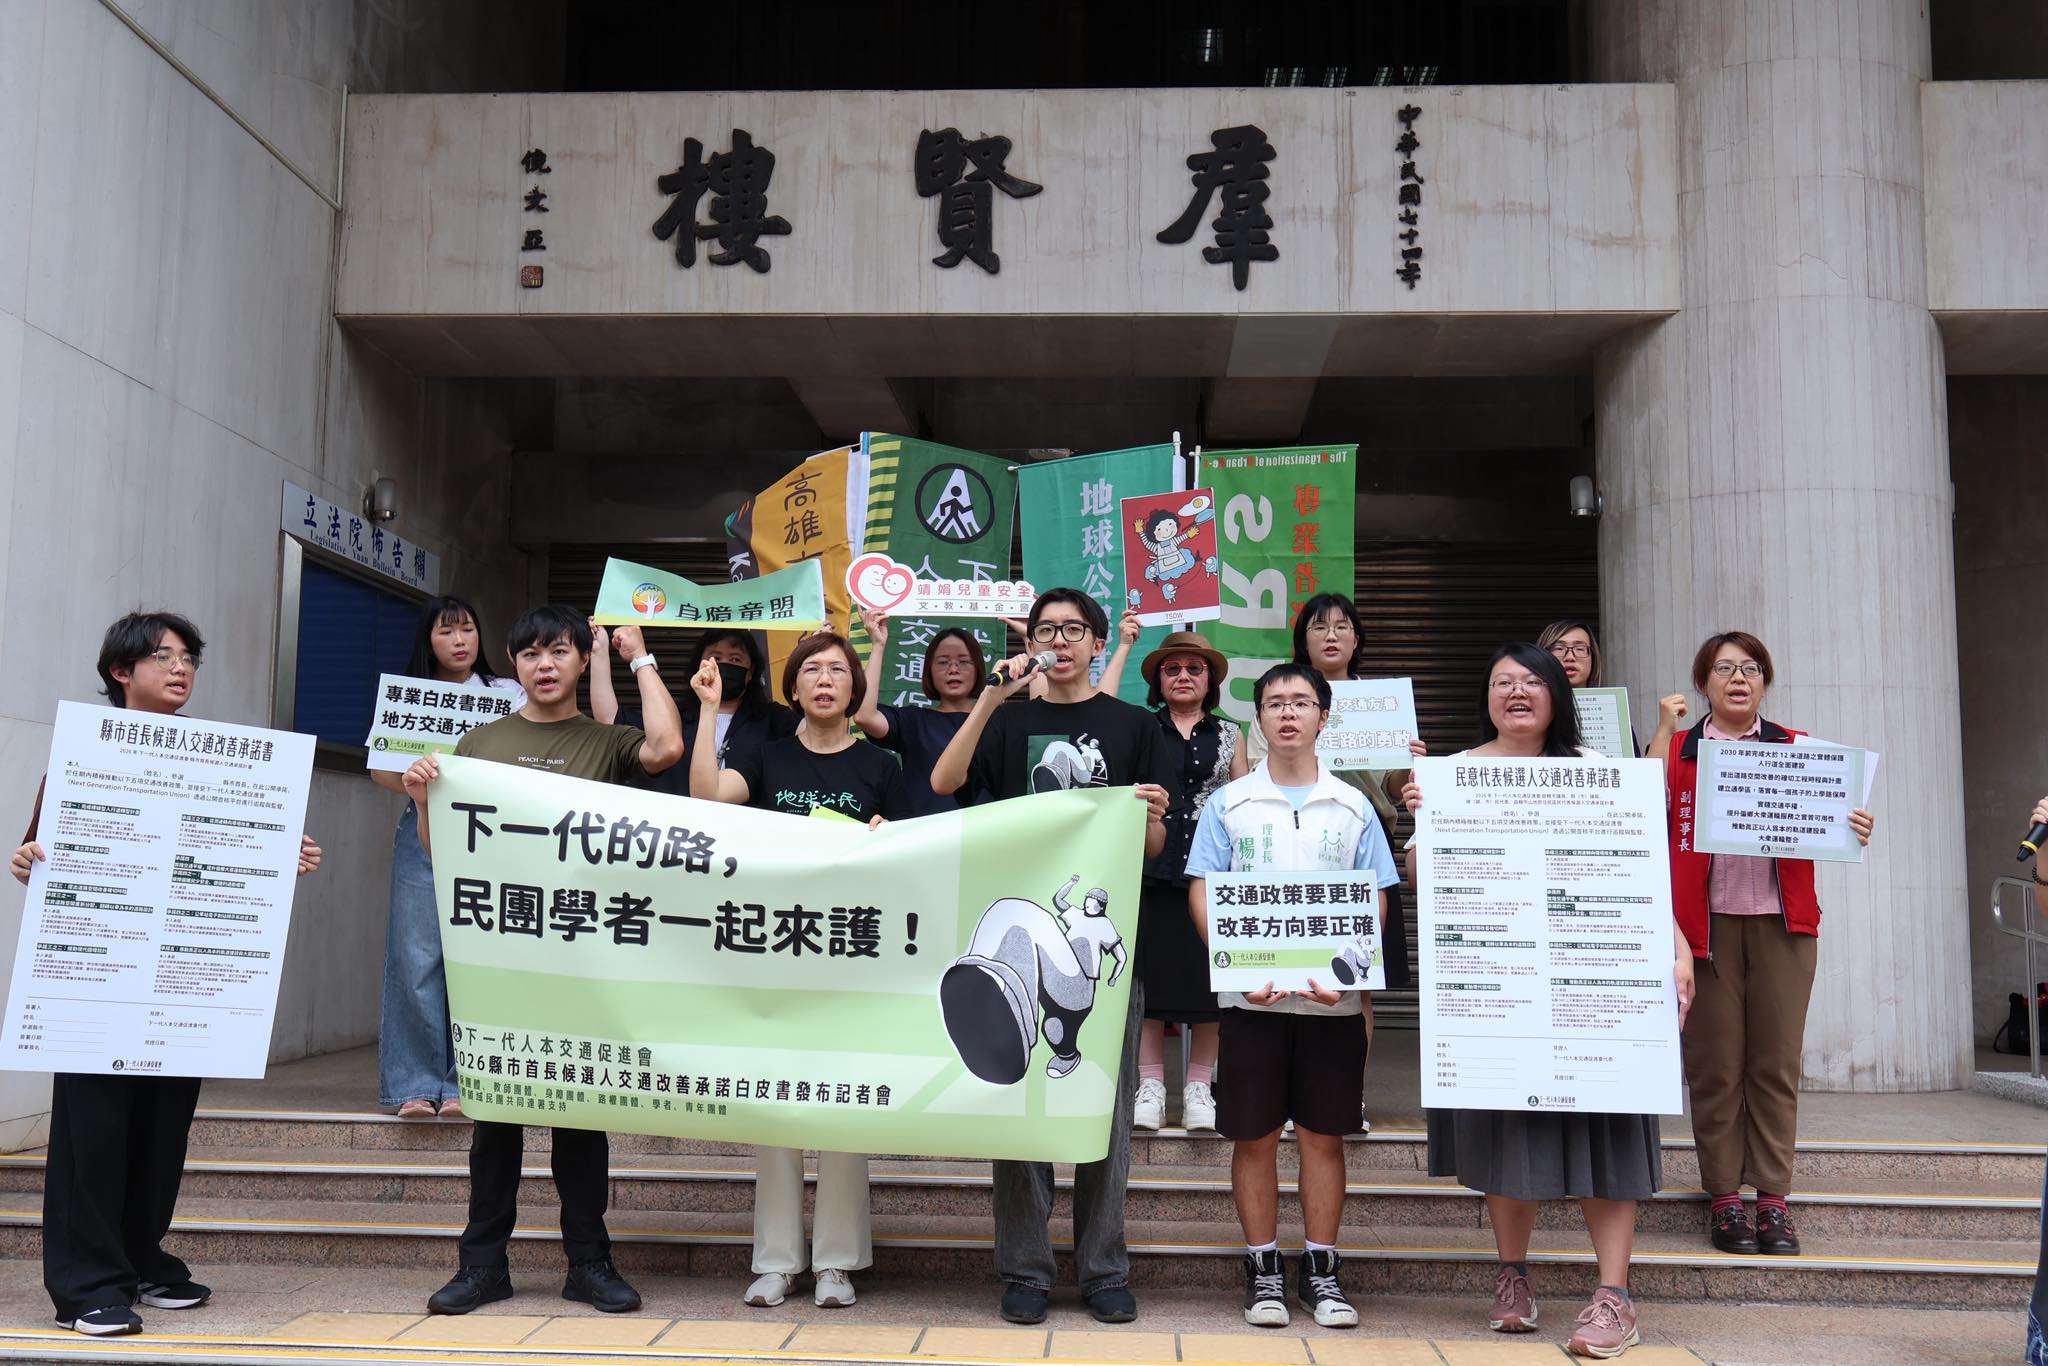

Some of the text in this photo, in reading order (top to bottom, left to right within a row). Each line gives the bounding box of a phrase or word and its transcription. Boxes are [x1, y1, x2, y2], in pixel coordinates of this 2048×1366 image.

[310, 530, 418, 586] Legislative Yuan Bulletin Board
[385, 684, 512, 717] 專業白皮書帶路
[99, 718, 274, 761] 縣市首長候選人交通改善承諾書
[1455, 766, 1621, 787] 民意代表候選人交通改善承諾書
[1215, 882, 1372, 906] 交通政策要更新
[1217, 914, 1375, 938] 改革方向要正確
[466, 1026, 652, 1068] 下一代人本交通促進會
